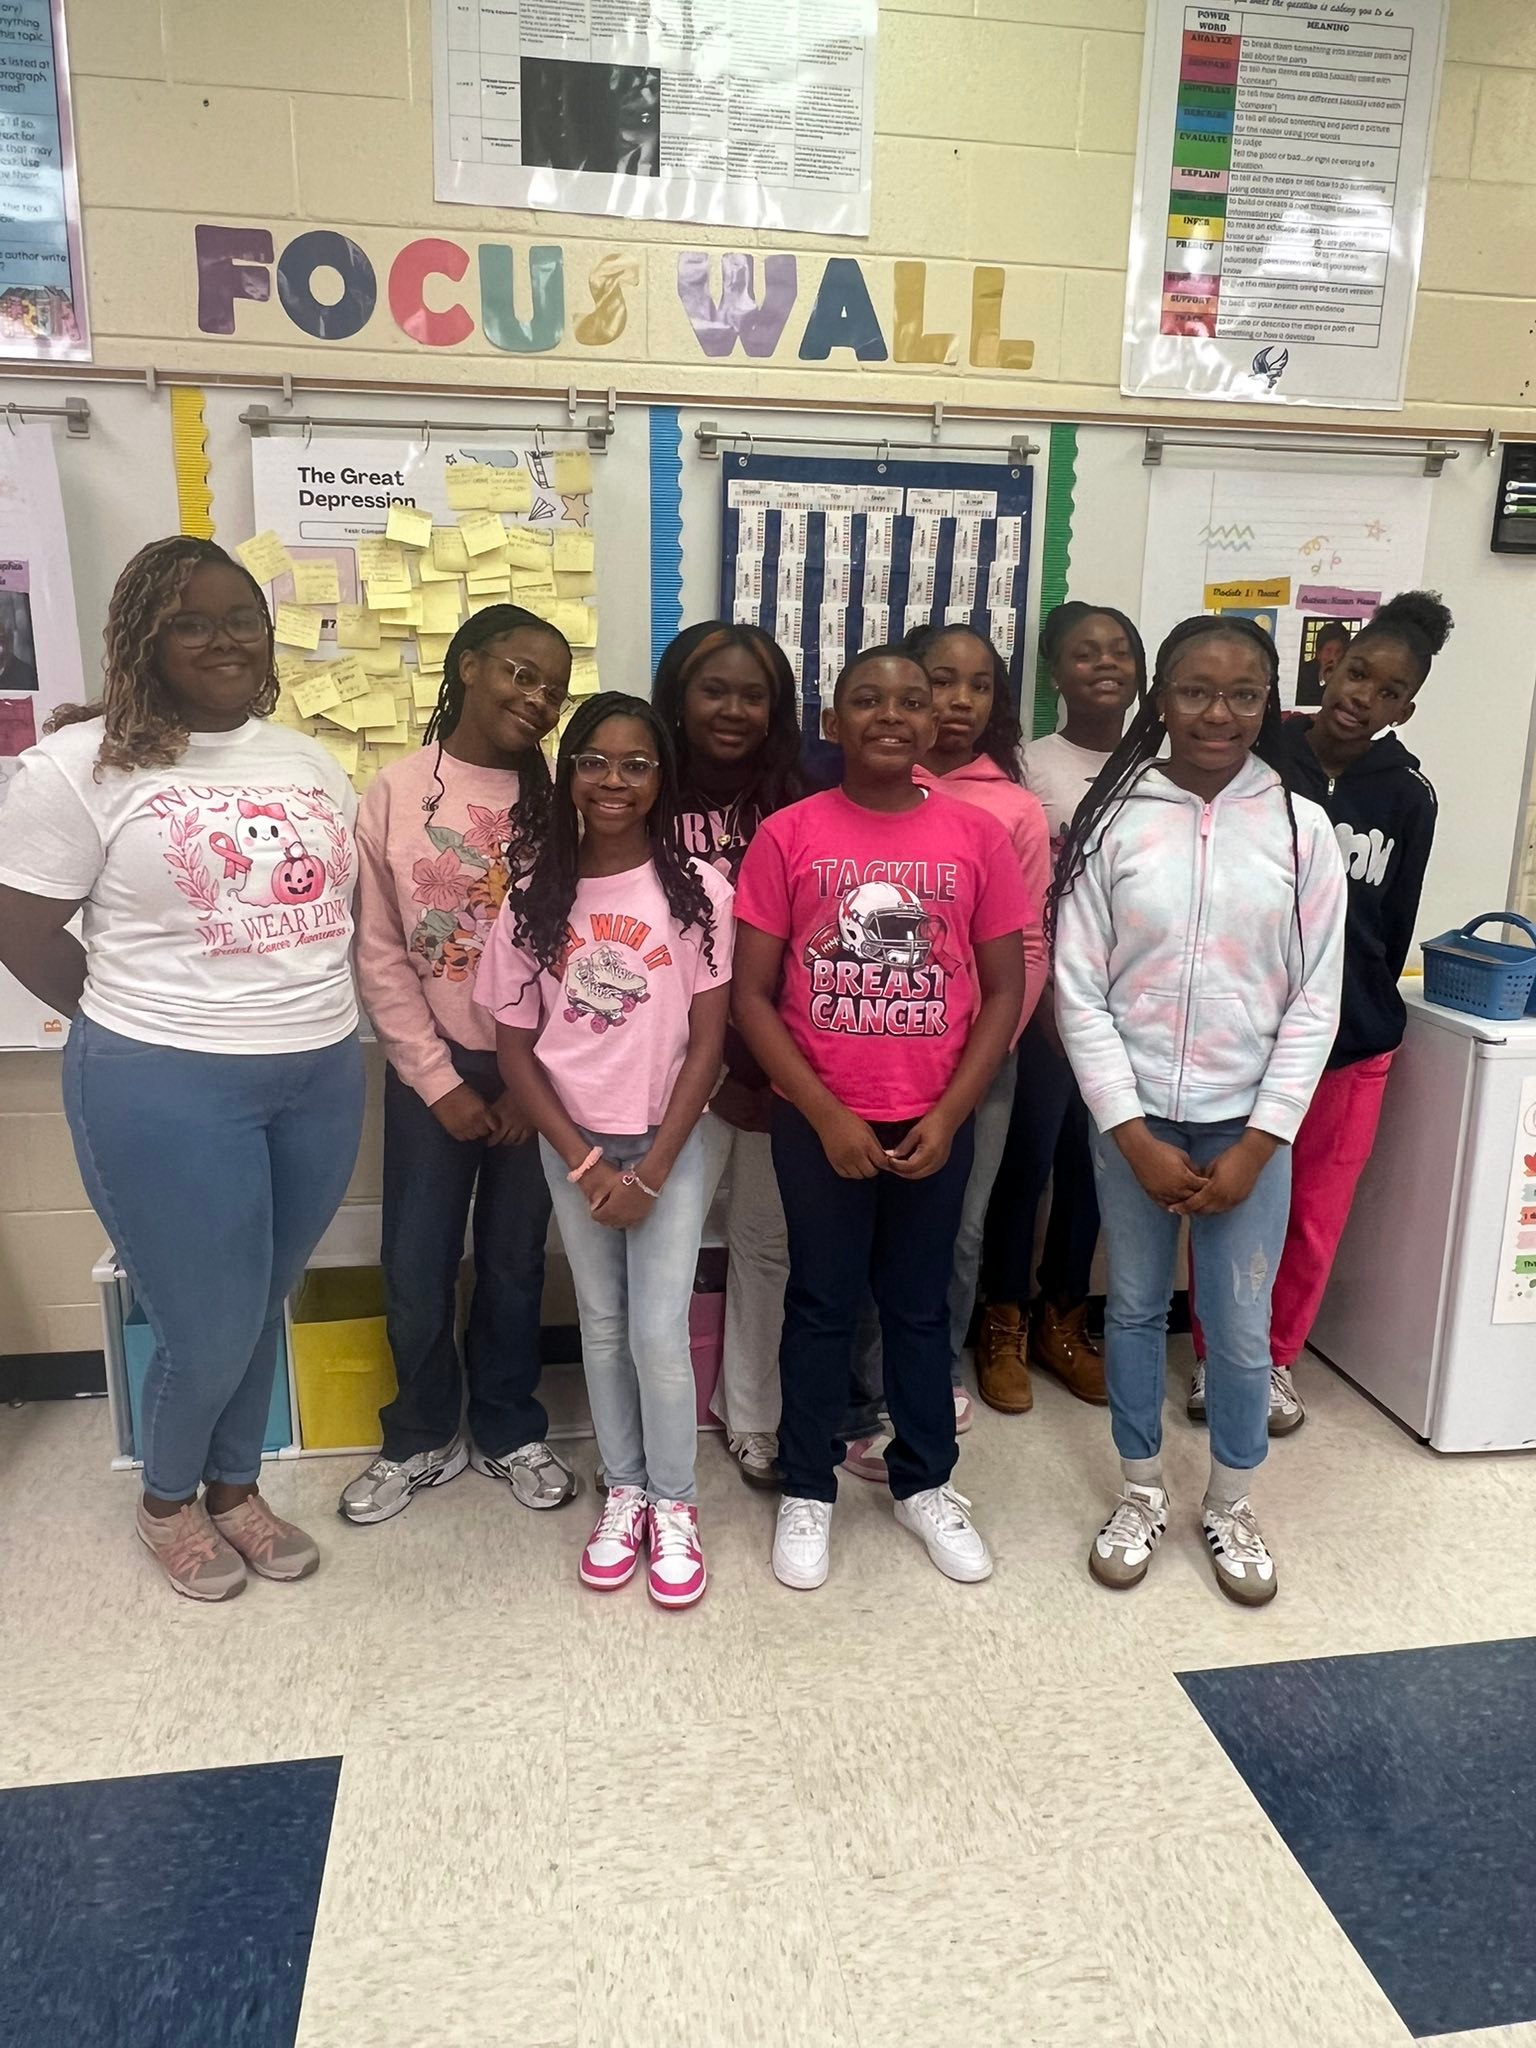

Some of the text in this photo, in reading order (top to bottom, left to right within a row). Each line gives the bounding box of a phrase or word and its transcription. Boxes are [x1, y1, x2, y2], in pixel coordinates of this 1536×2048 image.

[1197, 10, 1231, 21] POWER
[1199, 22, 1227, 32] WORD
[1306, 21, 1350, 32] MEANING
[8, 57, 37, 68] listed
[38, 61, 50, 69] at
[1179, 132, 1228, 144] EVALUATE
[1180, 168, 1221, 179] EXPLAIN
[5, 251, 67, 262] author write
[194, 225, 1036, 371] FOCUS WALL
[1170, 294, 1212, 305] SUPPORT
[297, 466, 405, 487] The Great
[299, 489, 417, 512] Depression
[812, 858, 957, 903] TACKLE
[195, 898, 347, 946] WE WEAR PINK
[590, 913, 673, 971] WITH IT
[812, 958, 946, 999] BREAST
[810, 993, 948, 1035] CANCER
